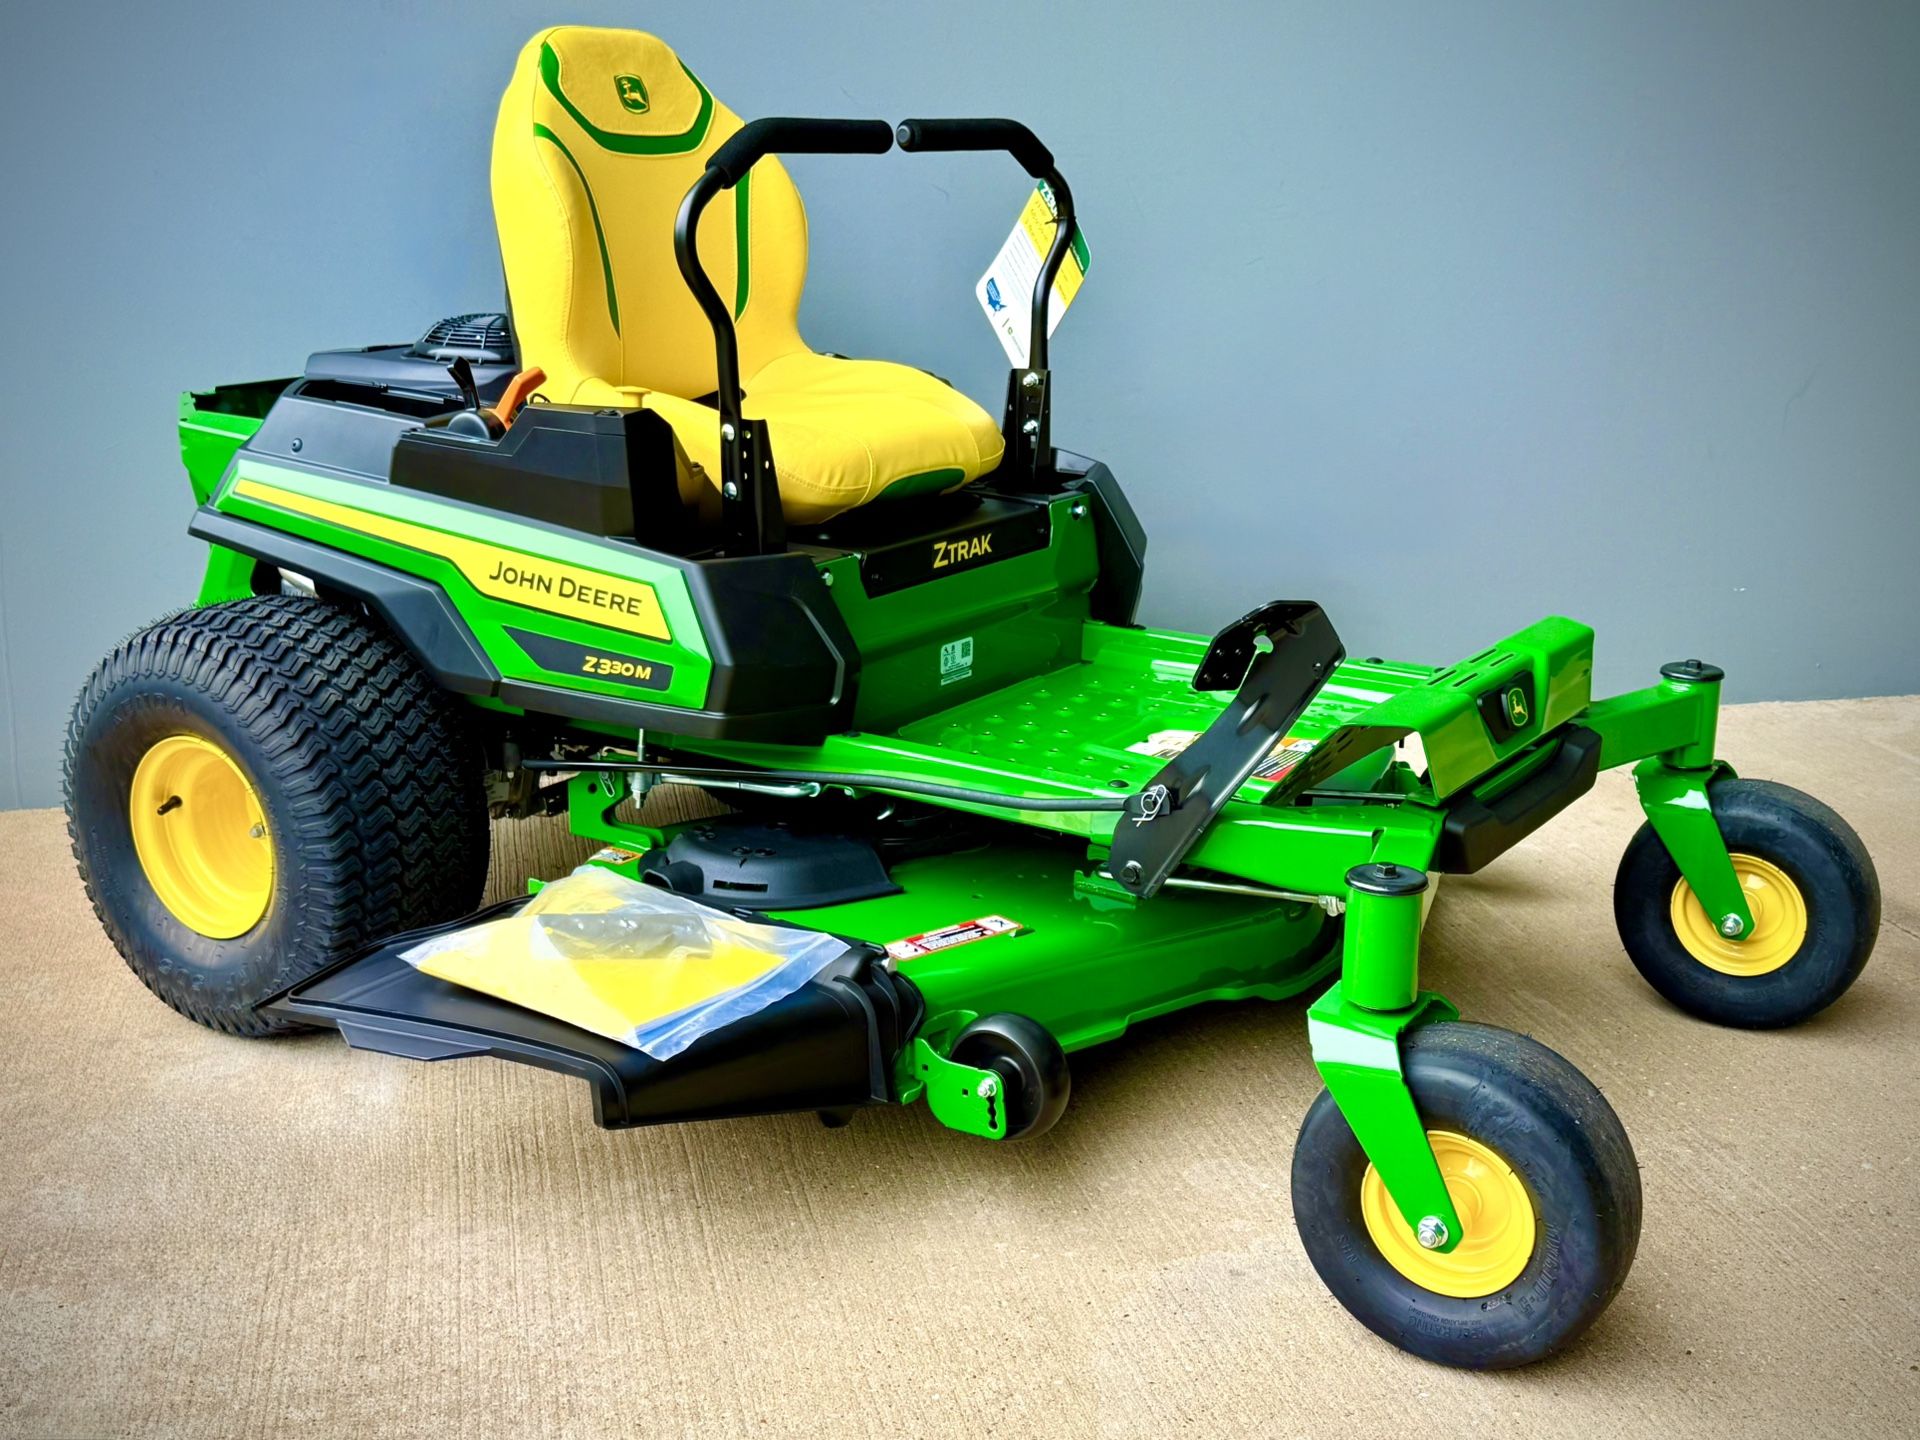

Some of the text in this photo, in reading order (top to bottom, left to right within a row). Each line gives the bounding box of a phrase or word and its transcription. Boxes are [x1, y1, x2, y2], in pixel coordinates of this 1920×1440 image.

[933, 533, 992, 569] ZTRAK
[489, 561, 642, 616] JOHN DEERE
[582, 655, 652, 680] Z330M
